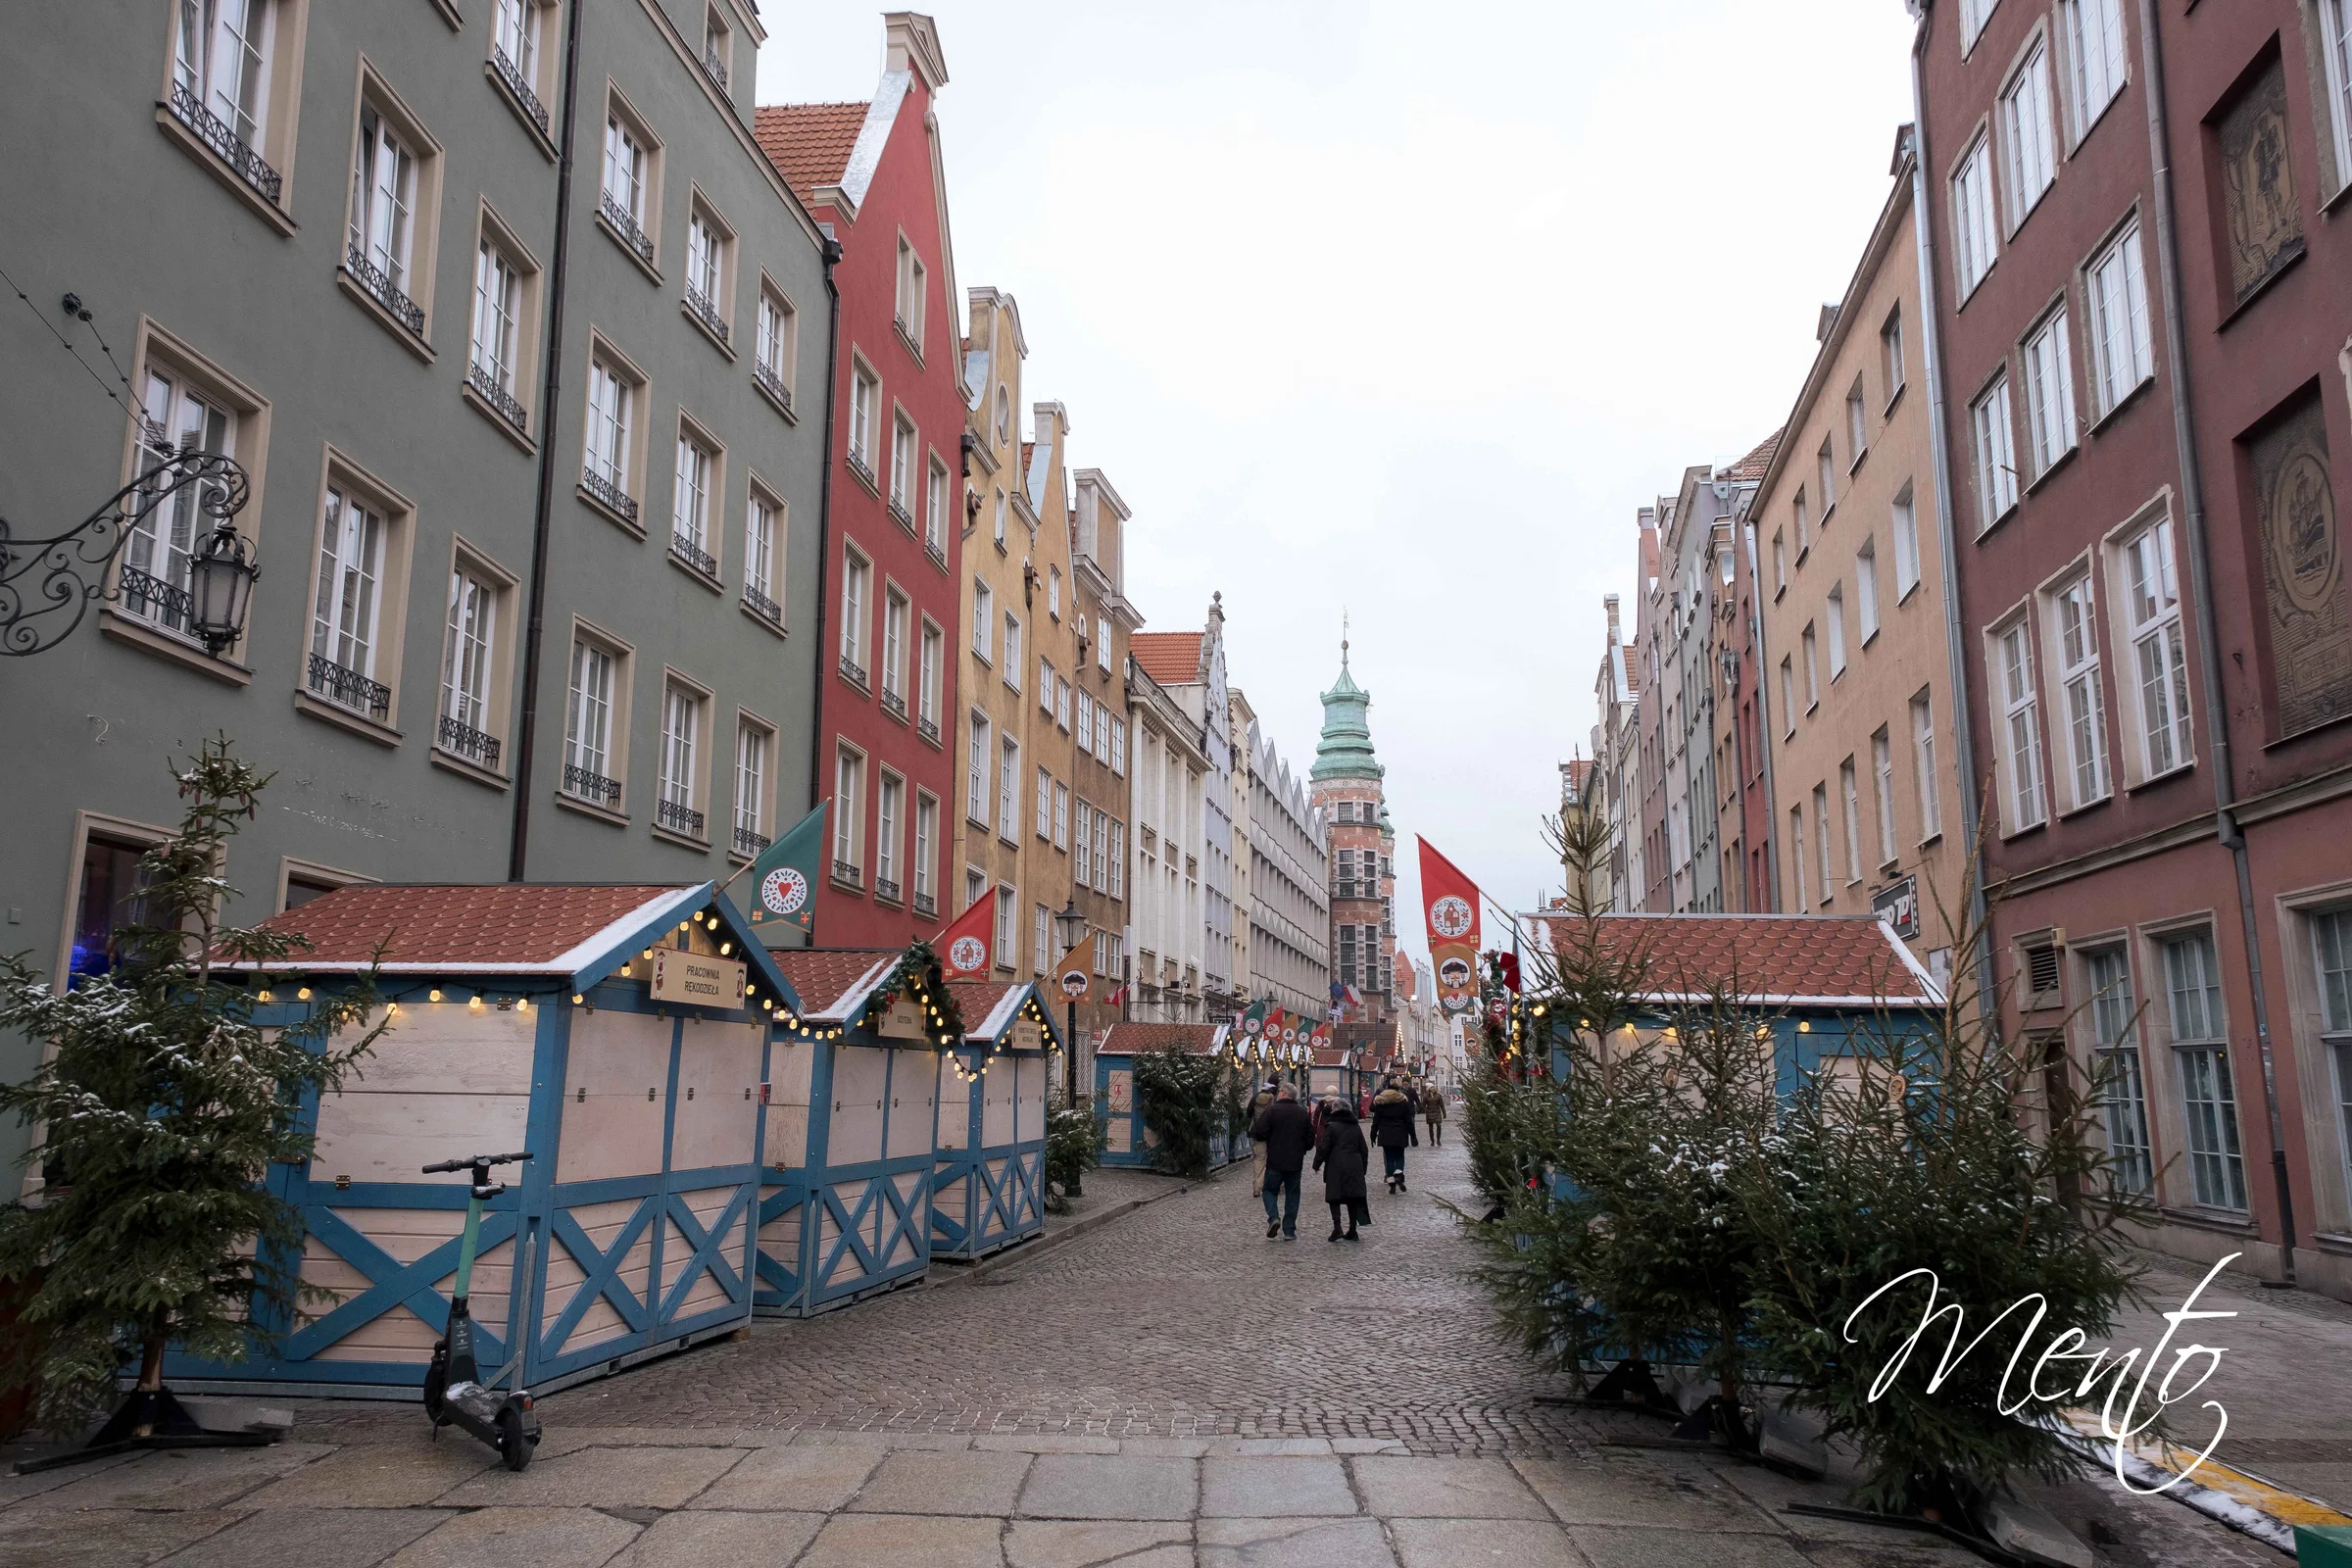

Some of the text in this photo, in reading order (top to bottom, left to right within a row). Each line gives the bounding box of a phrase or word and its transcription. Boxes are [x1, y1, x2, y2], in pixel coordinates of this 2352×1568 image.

[1894, 894, 1910, 925] 7D
[686, 965, 719, 980] PRACOWNIA
[685, 981, 719, 996] RĘKODZIEŁA
